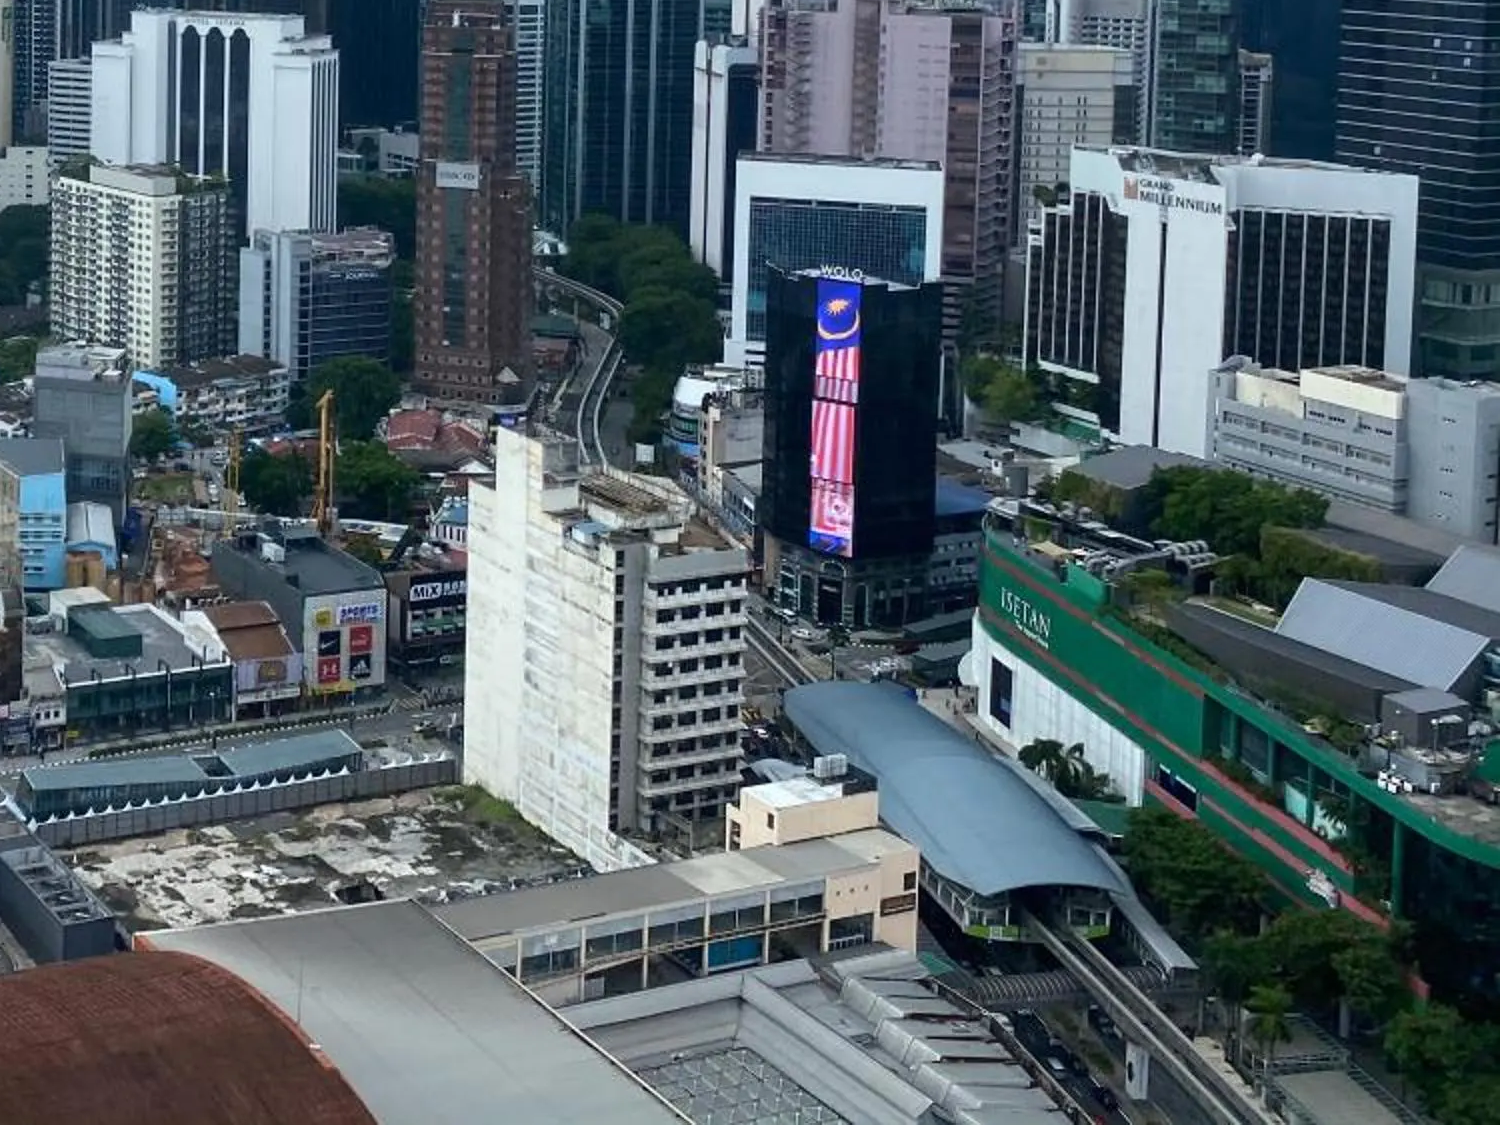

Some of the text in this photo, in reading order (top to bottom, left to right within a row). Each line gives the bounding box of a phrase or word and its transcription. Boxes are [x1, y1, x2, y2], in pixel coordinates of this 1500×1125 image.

[1139, 178, 1174, 191] GRAND
[1139, 191, 1222, 215] MILLENNIUM
[820, 264, 863, 279] WOLO
[413, 584, 439, 599] MIX
[1001, 586, 1051, 638] ISETAN
